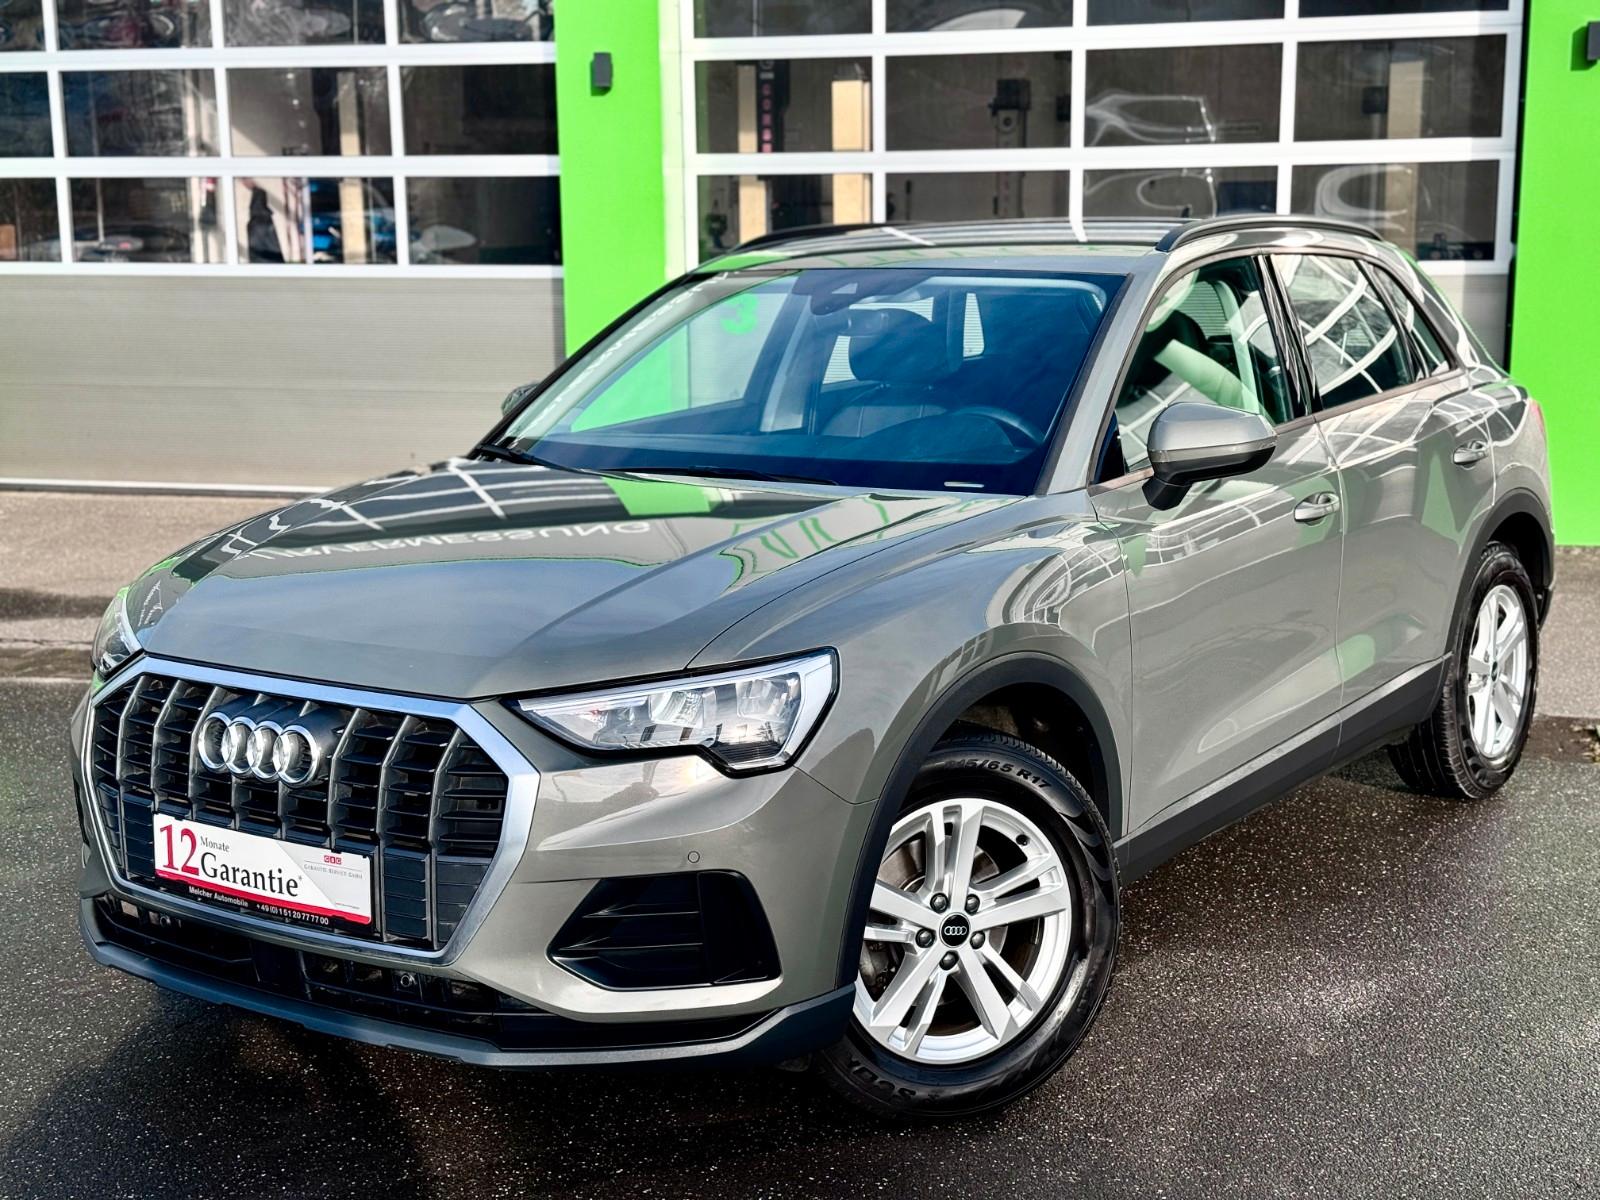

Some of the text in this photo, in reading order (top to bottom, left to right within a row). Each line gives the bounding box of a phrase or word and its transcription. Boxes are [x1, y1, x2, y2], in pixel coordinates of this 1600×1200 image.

[1016, 768, 1051, 788] R17
[160, 823, 200, 876] 12
[200, 835, 230, 853] Monate
[189, 885, 213, 898] Melcher
[214, 892, 248, 907] Automobile
